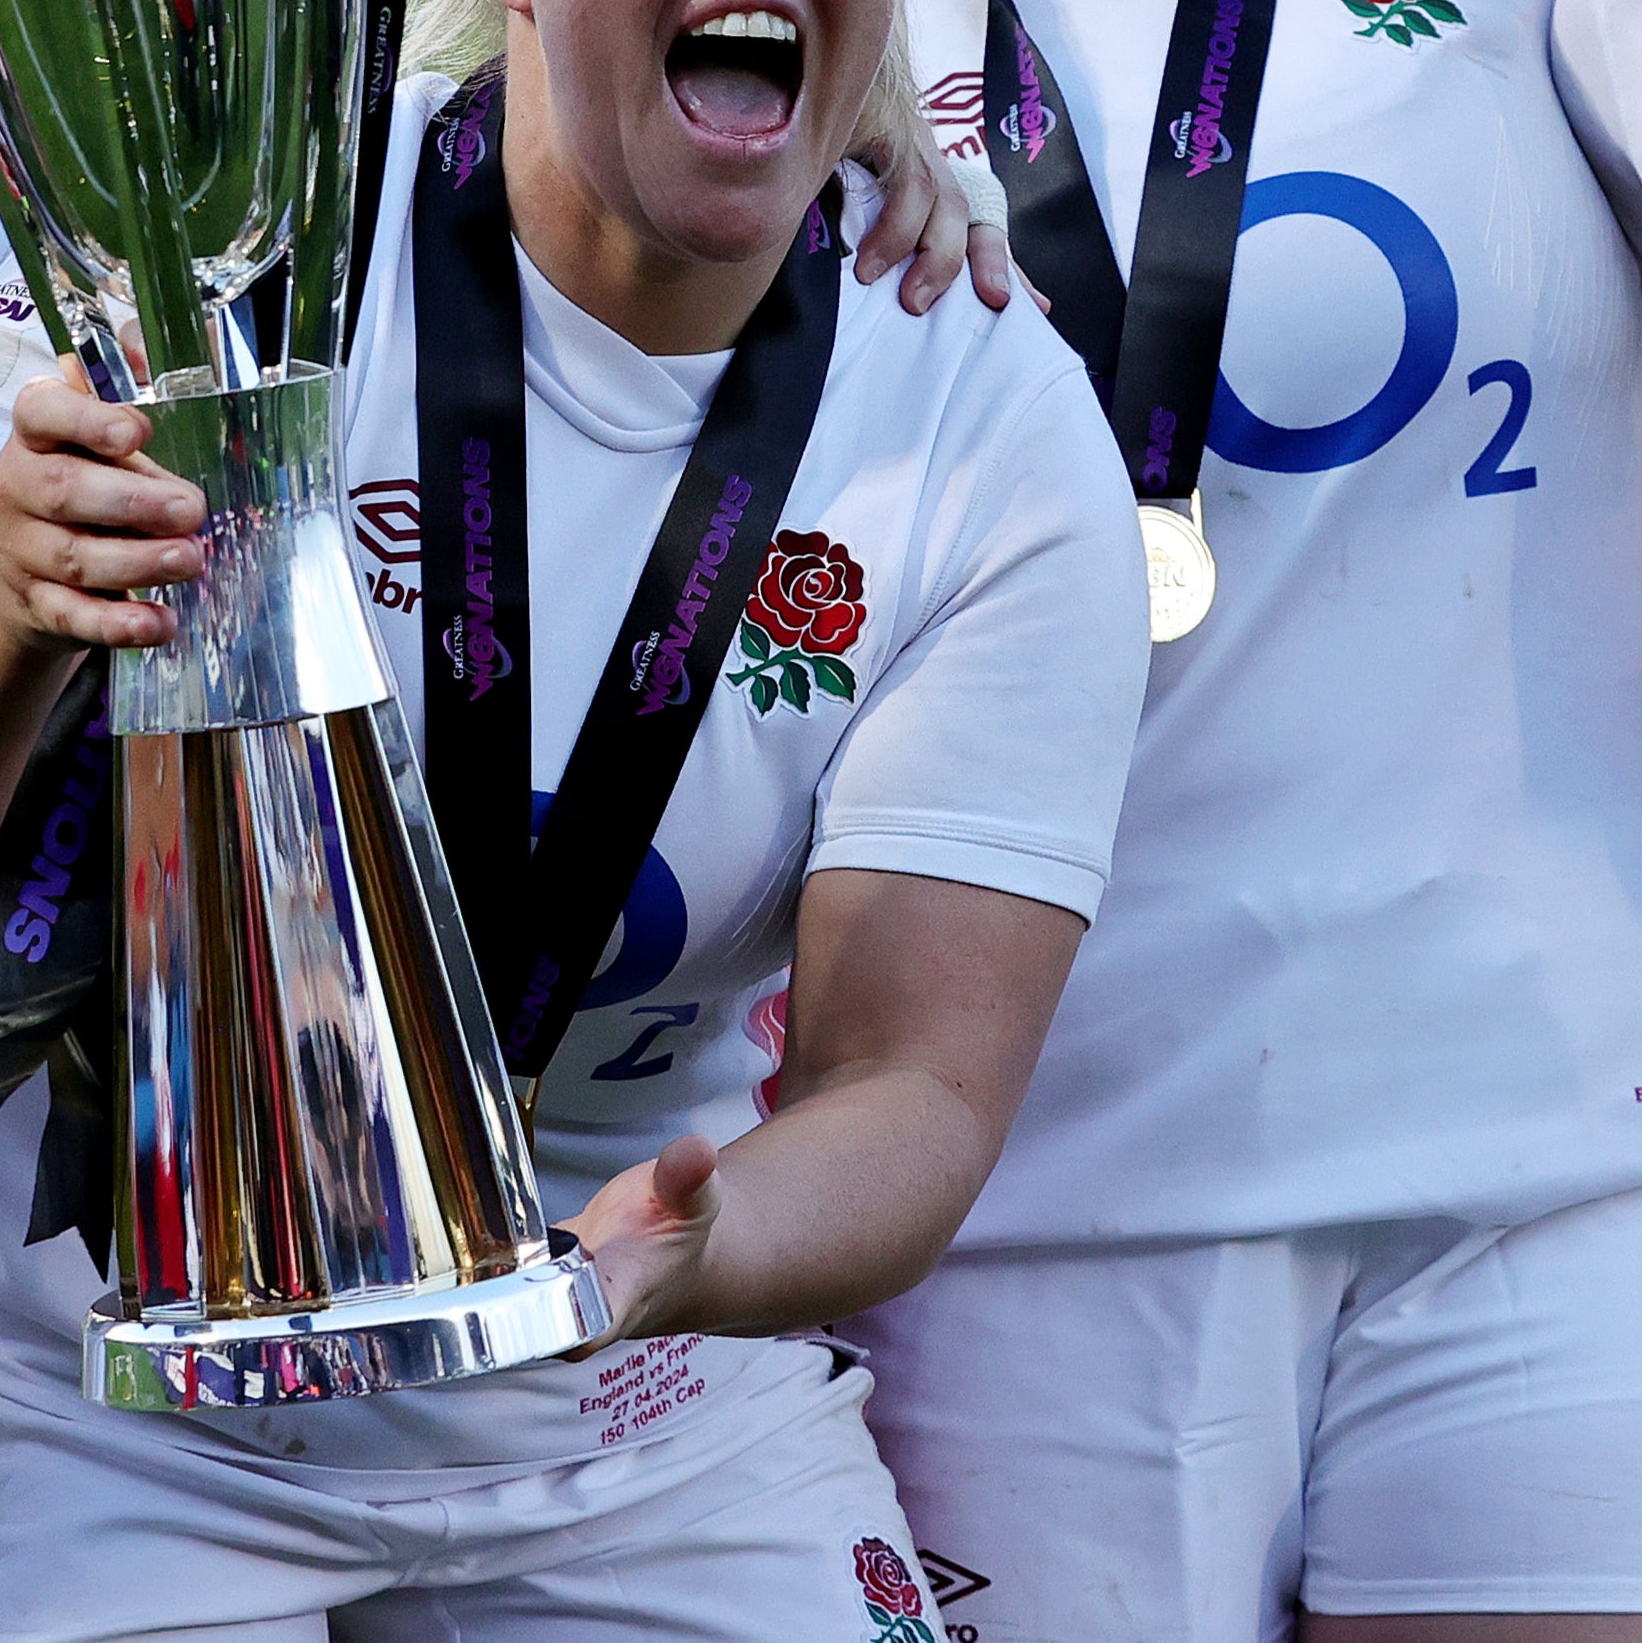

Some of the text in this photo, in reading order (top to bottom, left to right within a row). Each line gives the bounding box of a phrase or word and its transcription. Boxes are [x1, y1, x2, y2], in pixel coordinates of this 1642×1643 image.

[367, 6, 393, 114] GREATNESS
[629, 630, 661, 692] GREATNESS
[580, 1370, 644, 1414] England
[601, 1422, 625, 1445] 150
[675, 1378, 705, 1403] Cap
